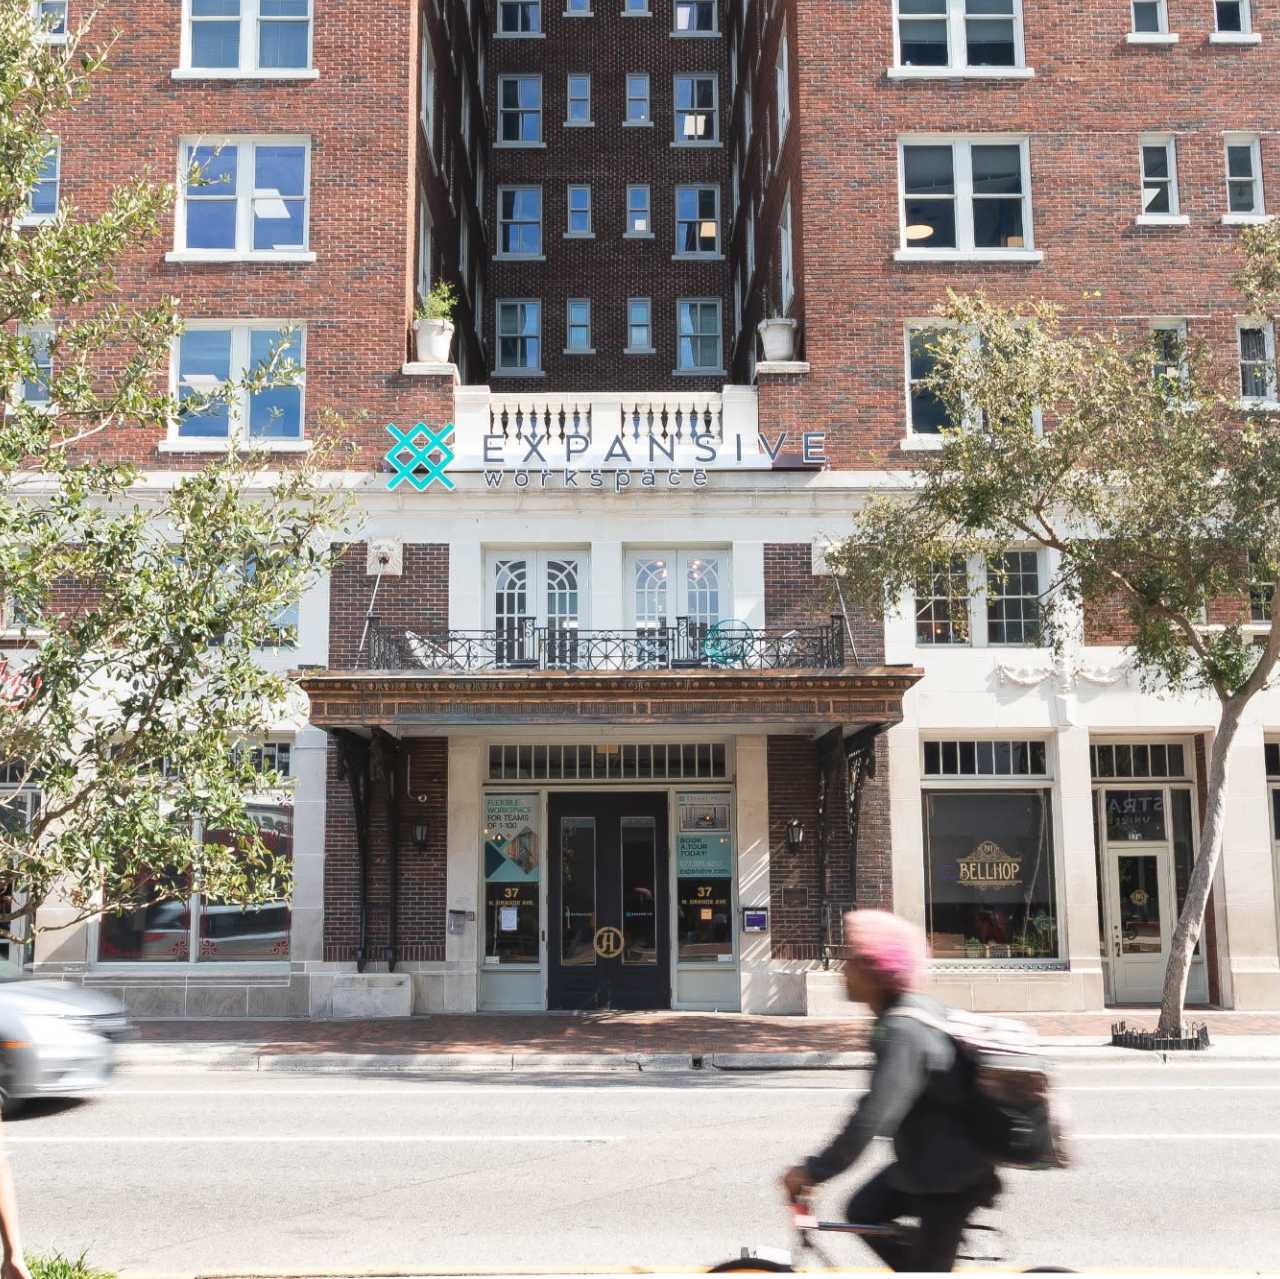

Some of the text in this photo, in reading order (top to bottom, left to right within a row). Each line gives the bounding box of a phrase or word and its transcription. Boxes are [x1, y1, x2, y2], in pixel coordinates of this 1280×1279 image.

[483, 432, 827, 464] EXPANSIVE
[484, 469, 709, 492] workspace
[960, 863, 1019, 880] BELLHOP
[504, 887, 519, 898] 37
[697, 886, 713, 898] 37
